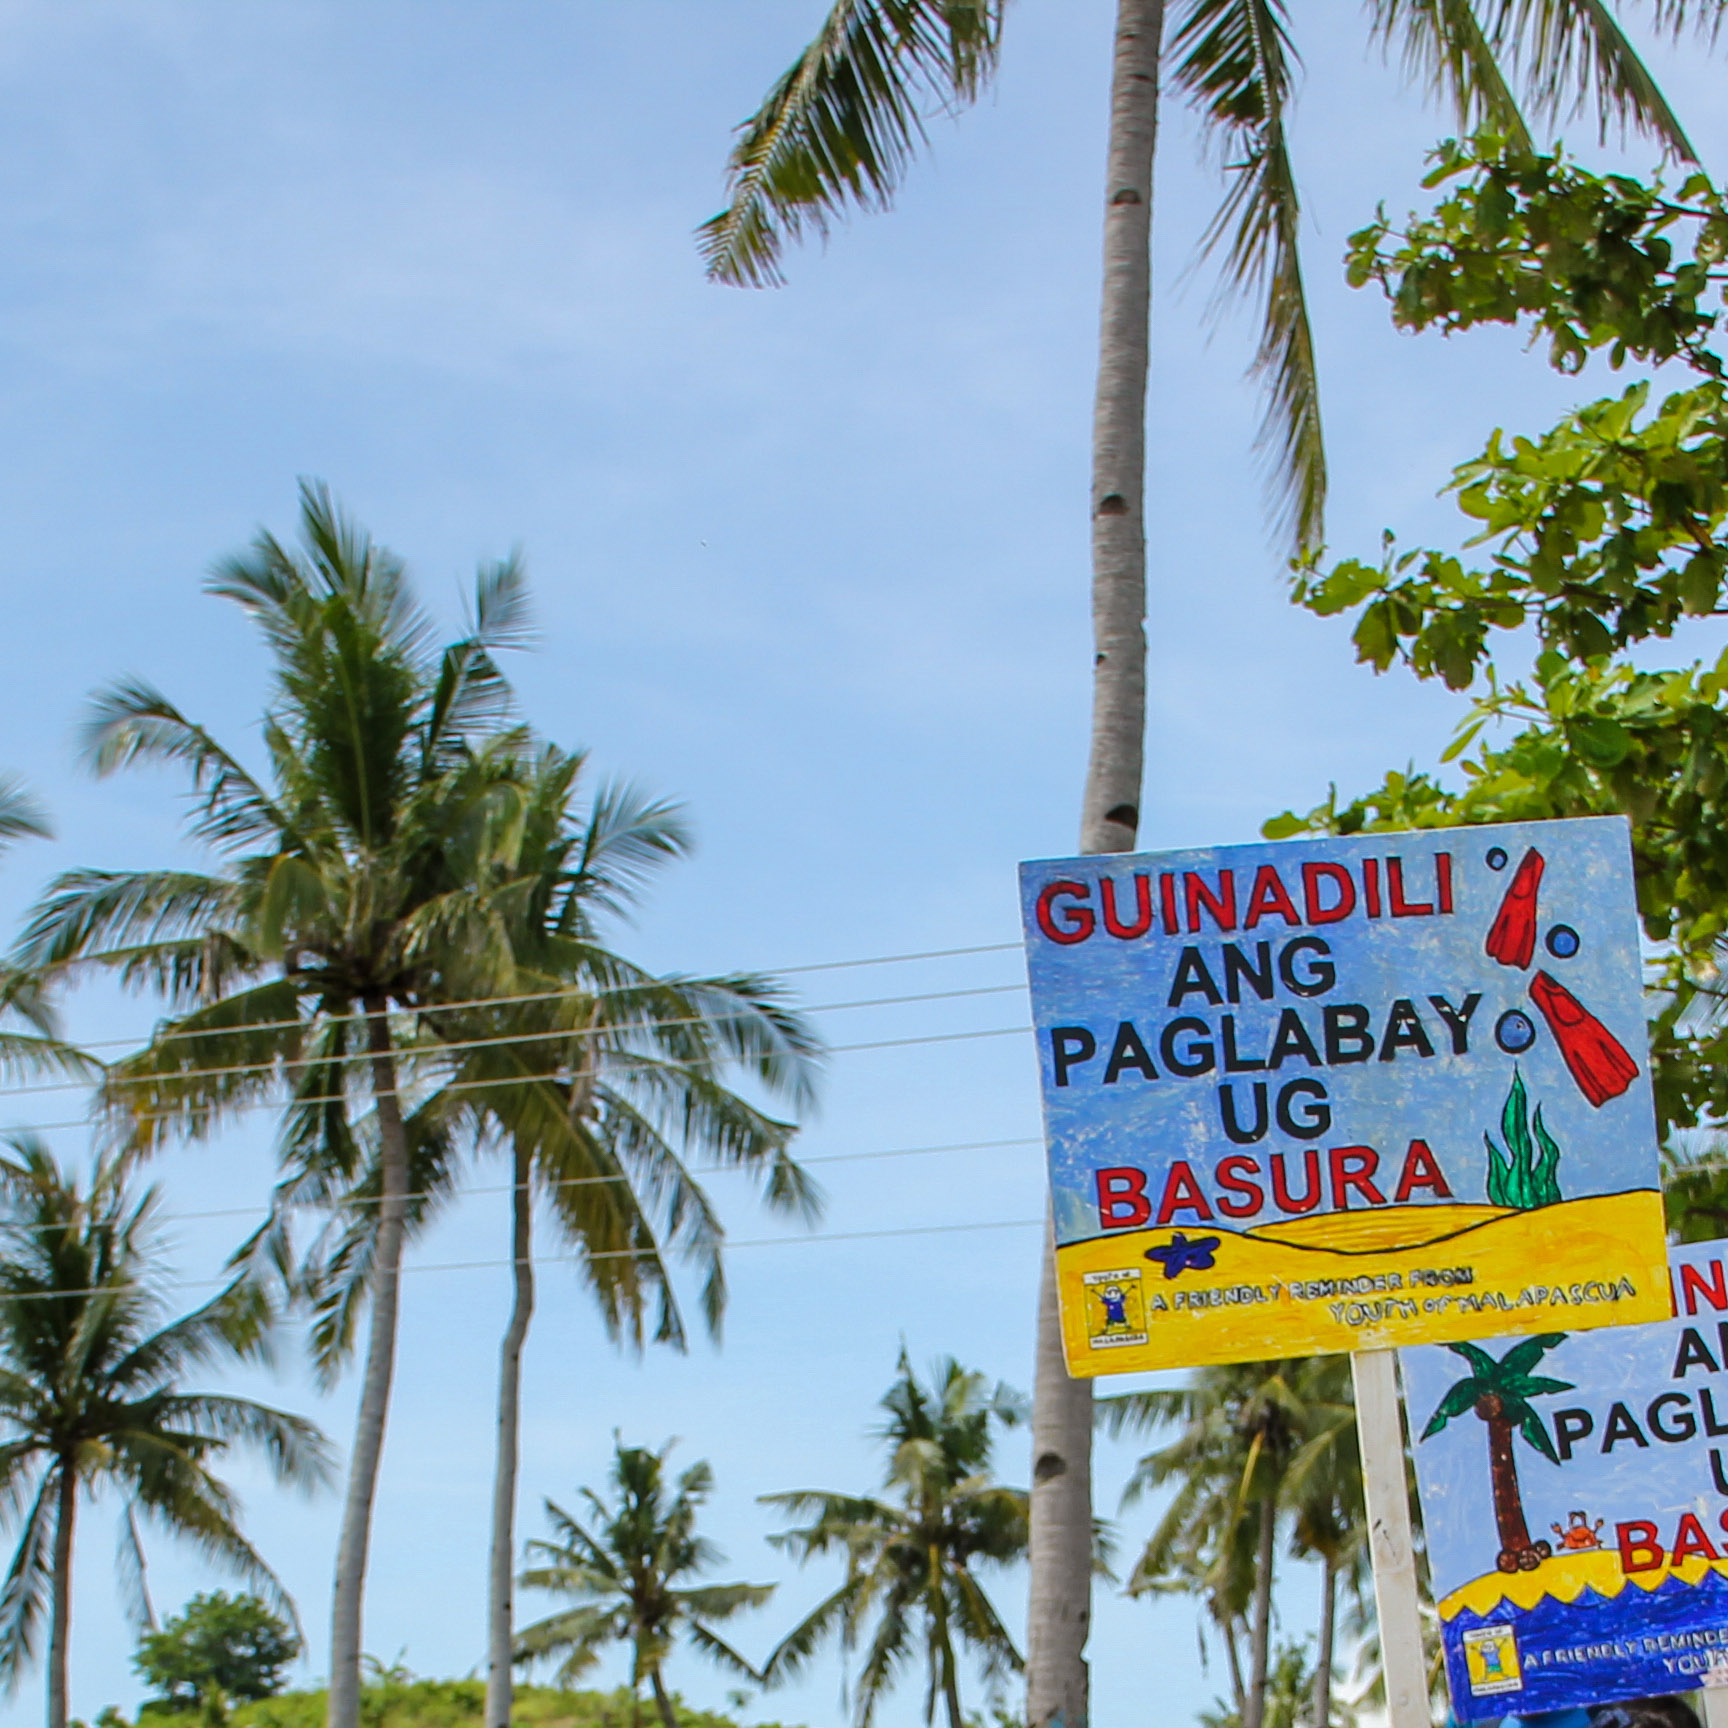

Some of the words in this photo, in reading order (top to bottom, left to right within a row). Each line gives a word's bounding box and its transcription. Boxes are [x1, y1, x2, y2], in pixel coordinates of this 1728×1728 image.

[1035, 852, 1454, 944] GUINADILI
[1167, 936, 1336, 1008] ANG
[1051, 993, 1483, 1087] PAGLABAY
[1218, 1078, 1331, 1144] UG
[1095, 1139, 1454, 1230] BASURA
[1151, 1293, 1168, 1311] A
[1174, 1284, 1282, 1310] FRIENDLY
[1288, 1272, 1403, 1300] REMINDER
[1409, 1266, 1473, 1288] FROM
[1329, 1299, 1418, 1327] YOUTH
[1458, 1276, 1636, 1312] MALAPASCUA
[1524, 1653, 1538, 1670] A
[1542, 1641, 1638, 1666] FRIENDLY
